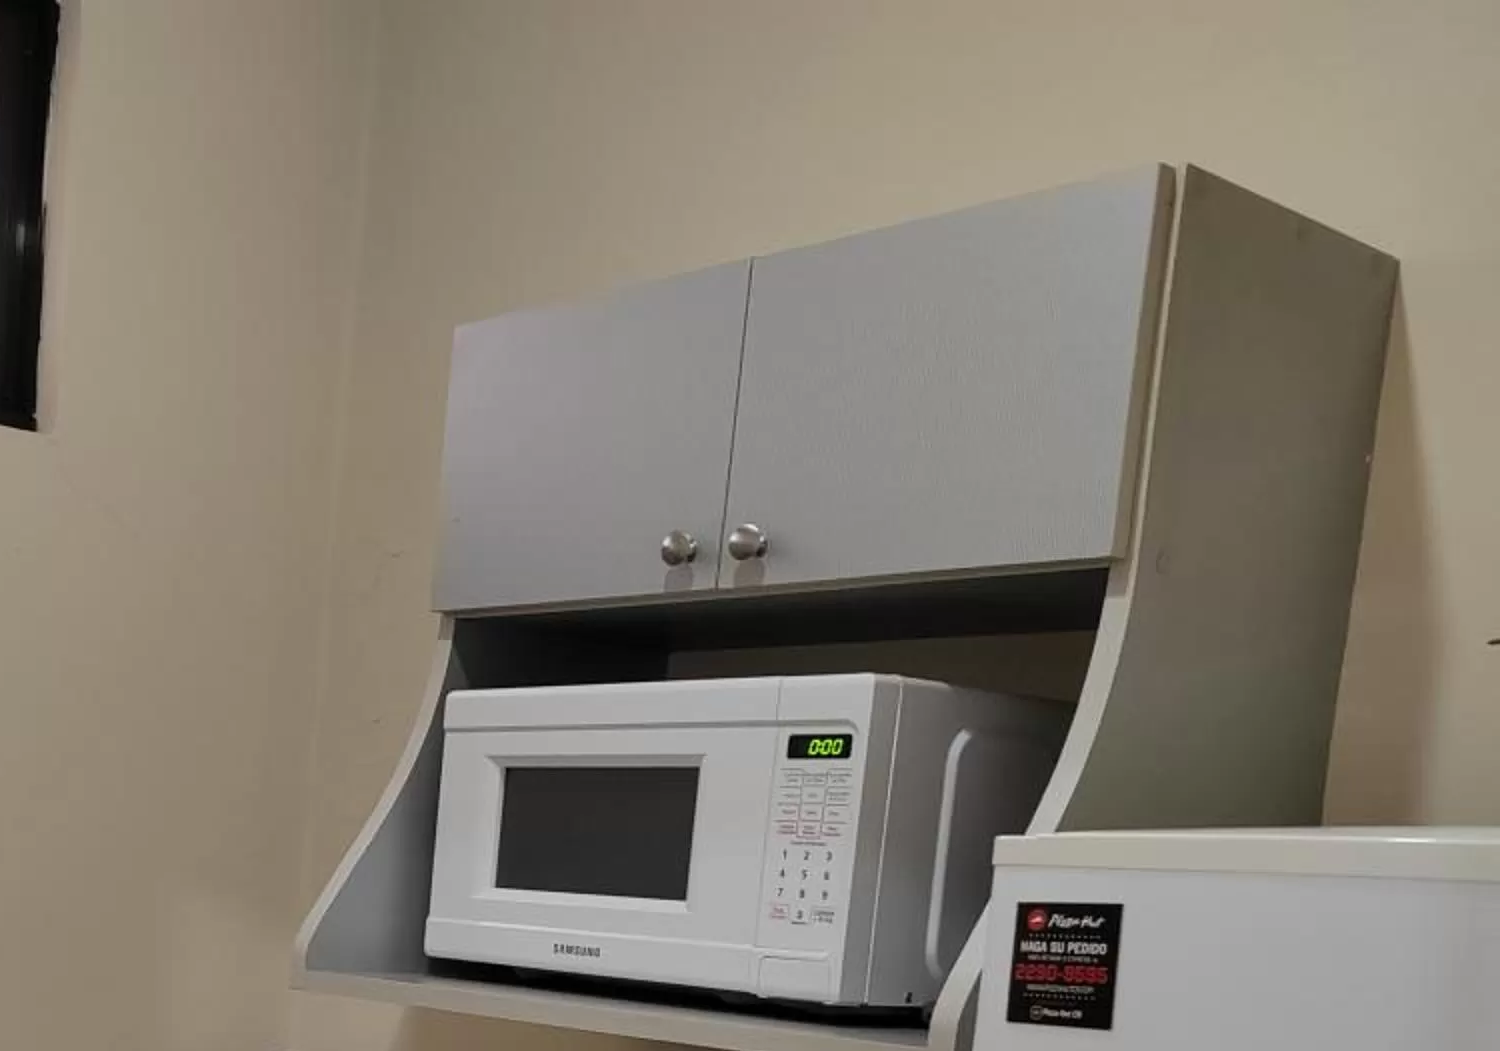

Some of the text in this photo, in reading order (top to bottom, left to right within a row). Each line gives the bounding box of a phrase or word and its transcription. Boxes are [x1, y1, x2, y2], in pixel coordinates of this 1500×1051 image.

[807, 738, 844, 756] 0:00
[553, 943, 601, 958] SAMSUNG
[1067, 942, 1108, 956] PEDIDO
